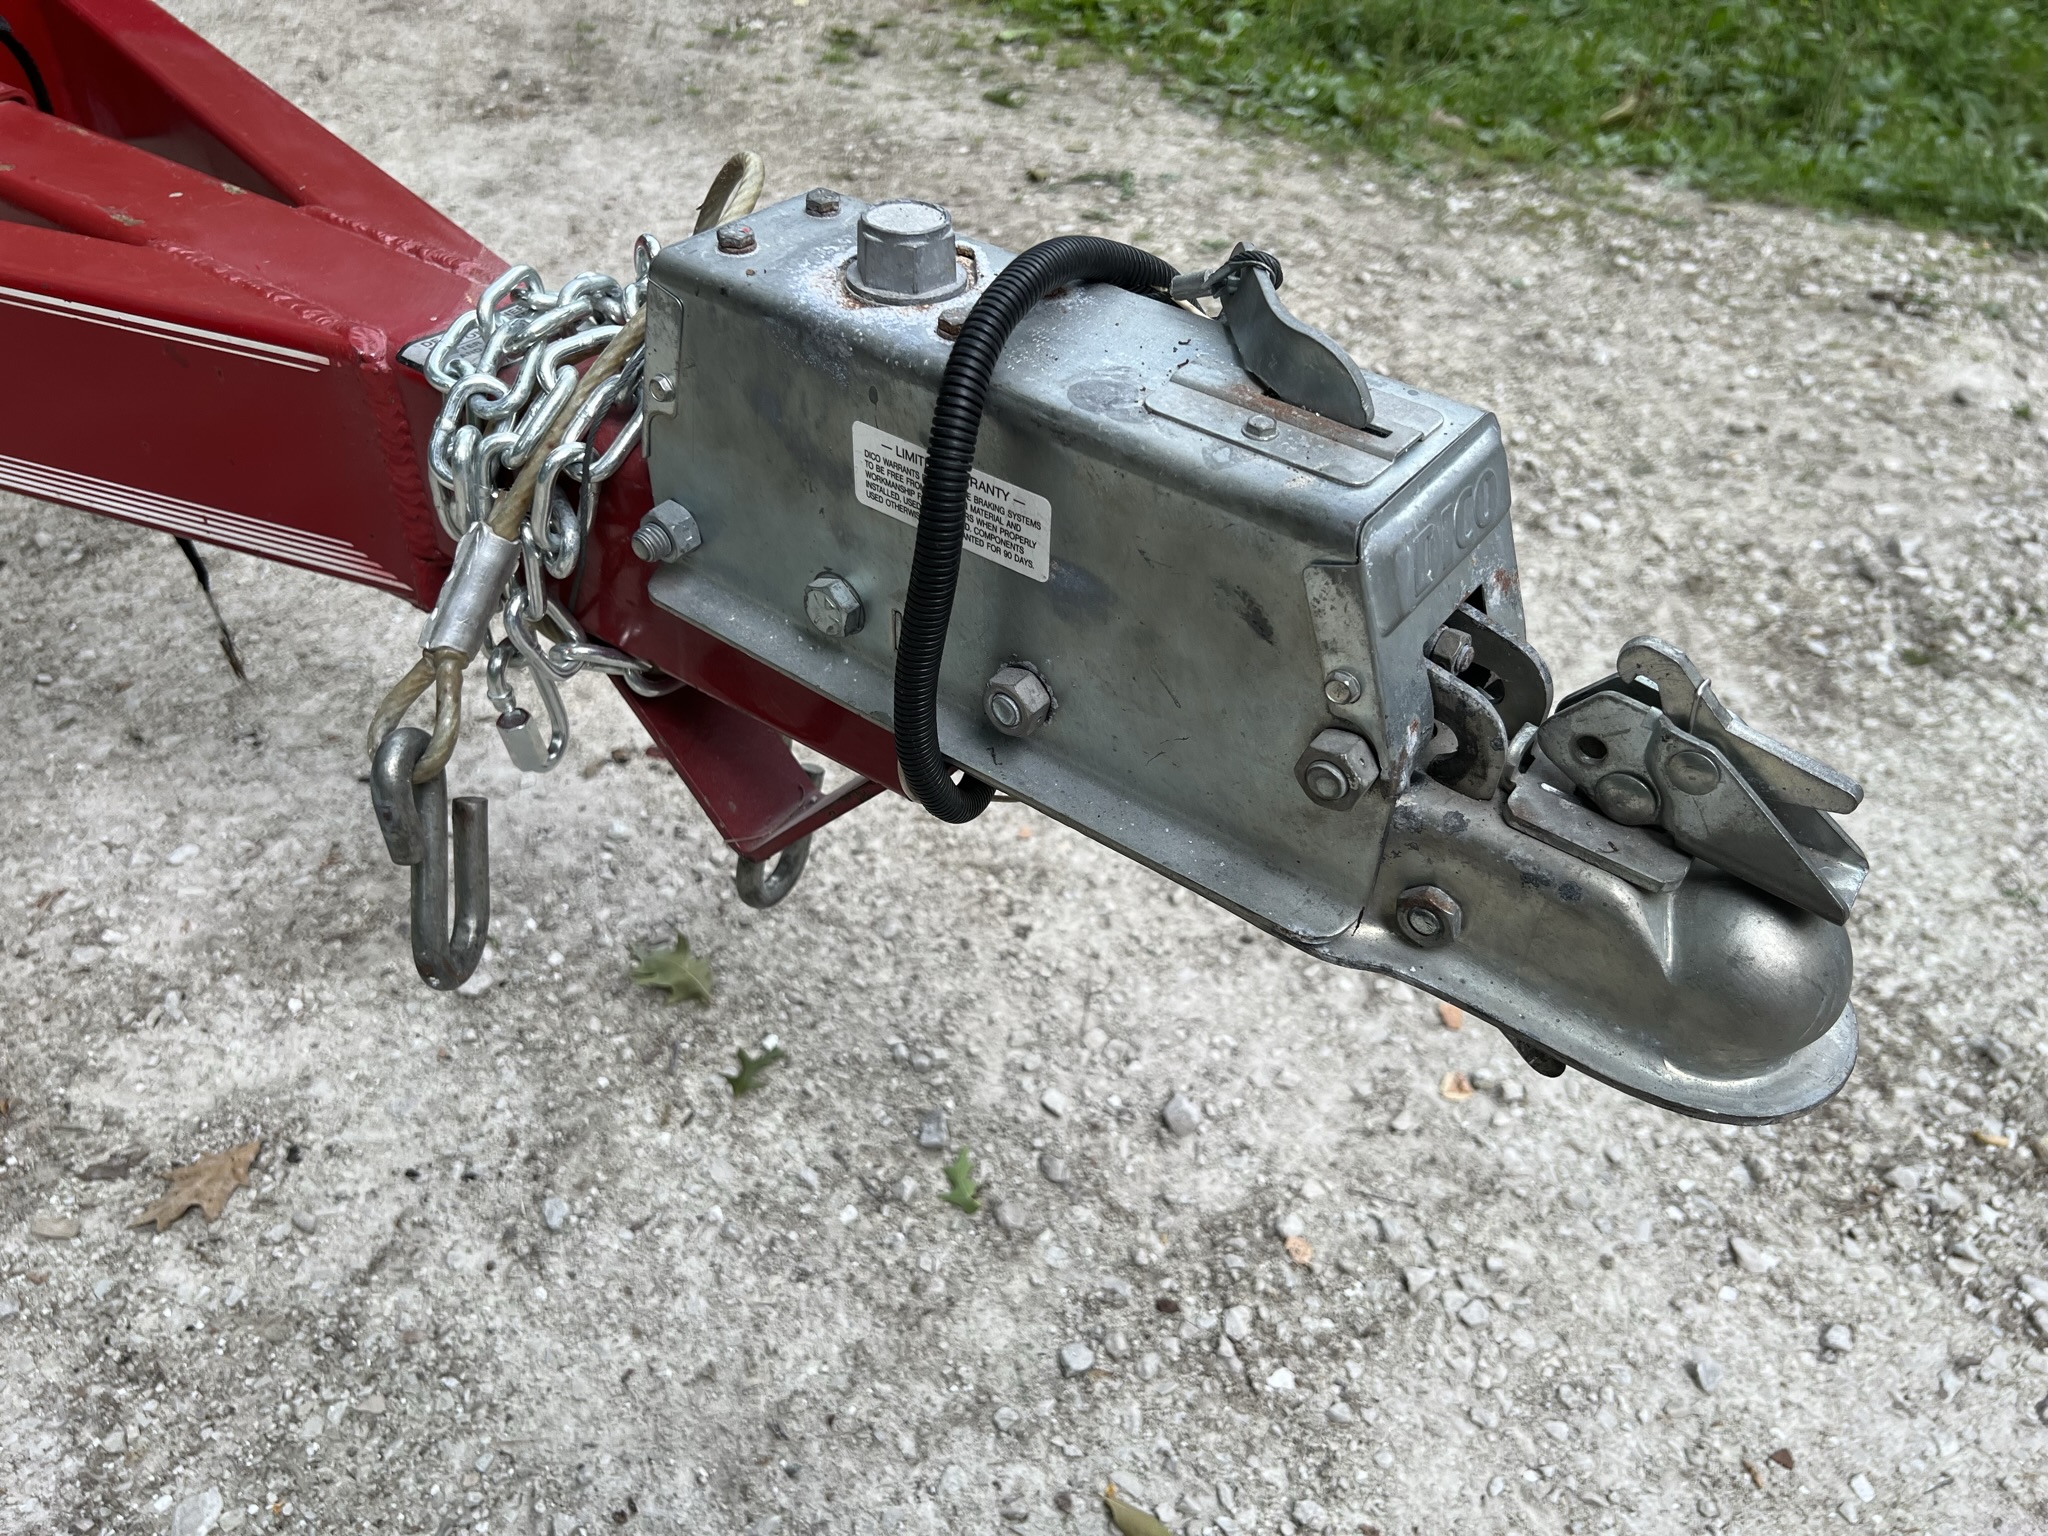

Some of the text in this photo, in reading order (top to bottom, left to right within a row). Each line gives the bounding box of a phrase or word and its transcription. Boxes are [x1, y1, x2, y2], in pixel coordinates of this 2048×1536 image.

[864, 449, 881, 462] DICO
[883, 457, 920, 480] WARRANTS
[973, 496, 1005, 515] BRAKING
[1007, 510, 1042, 531] SYSTEMS
[864, 459, 874, 470] TO
[875, 465, 885, 475] BE
[886, 469, 904, 483] FREE
[970, 505, 1004, 526] MATERIAL
[1006, 519, 1022, 533] AND
[865, 470, 915, 497] WORKMANSHIP
[976, 517, 998, 533] WHEN
[1000, 528, 1037, 549] PROPERLY
[896, 446, 924, 466] LIMIT
[969, 477, 1010, 501] RANTY
[866, 480, 902, 503] INSTALLED,
[974, 527, 1025, 555] COMPONENTS
[866, 490, 884, 504] USED
[886, 499, 920, 519] OTHERWIS
[987, 542, 1002, 555] FOR
[1004, 550, 1013, 560] 90
[1014, 554, 1035, 570] DAYS.
[1412, 467, 1501, 598] DICO
